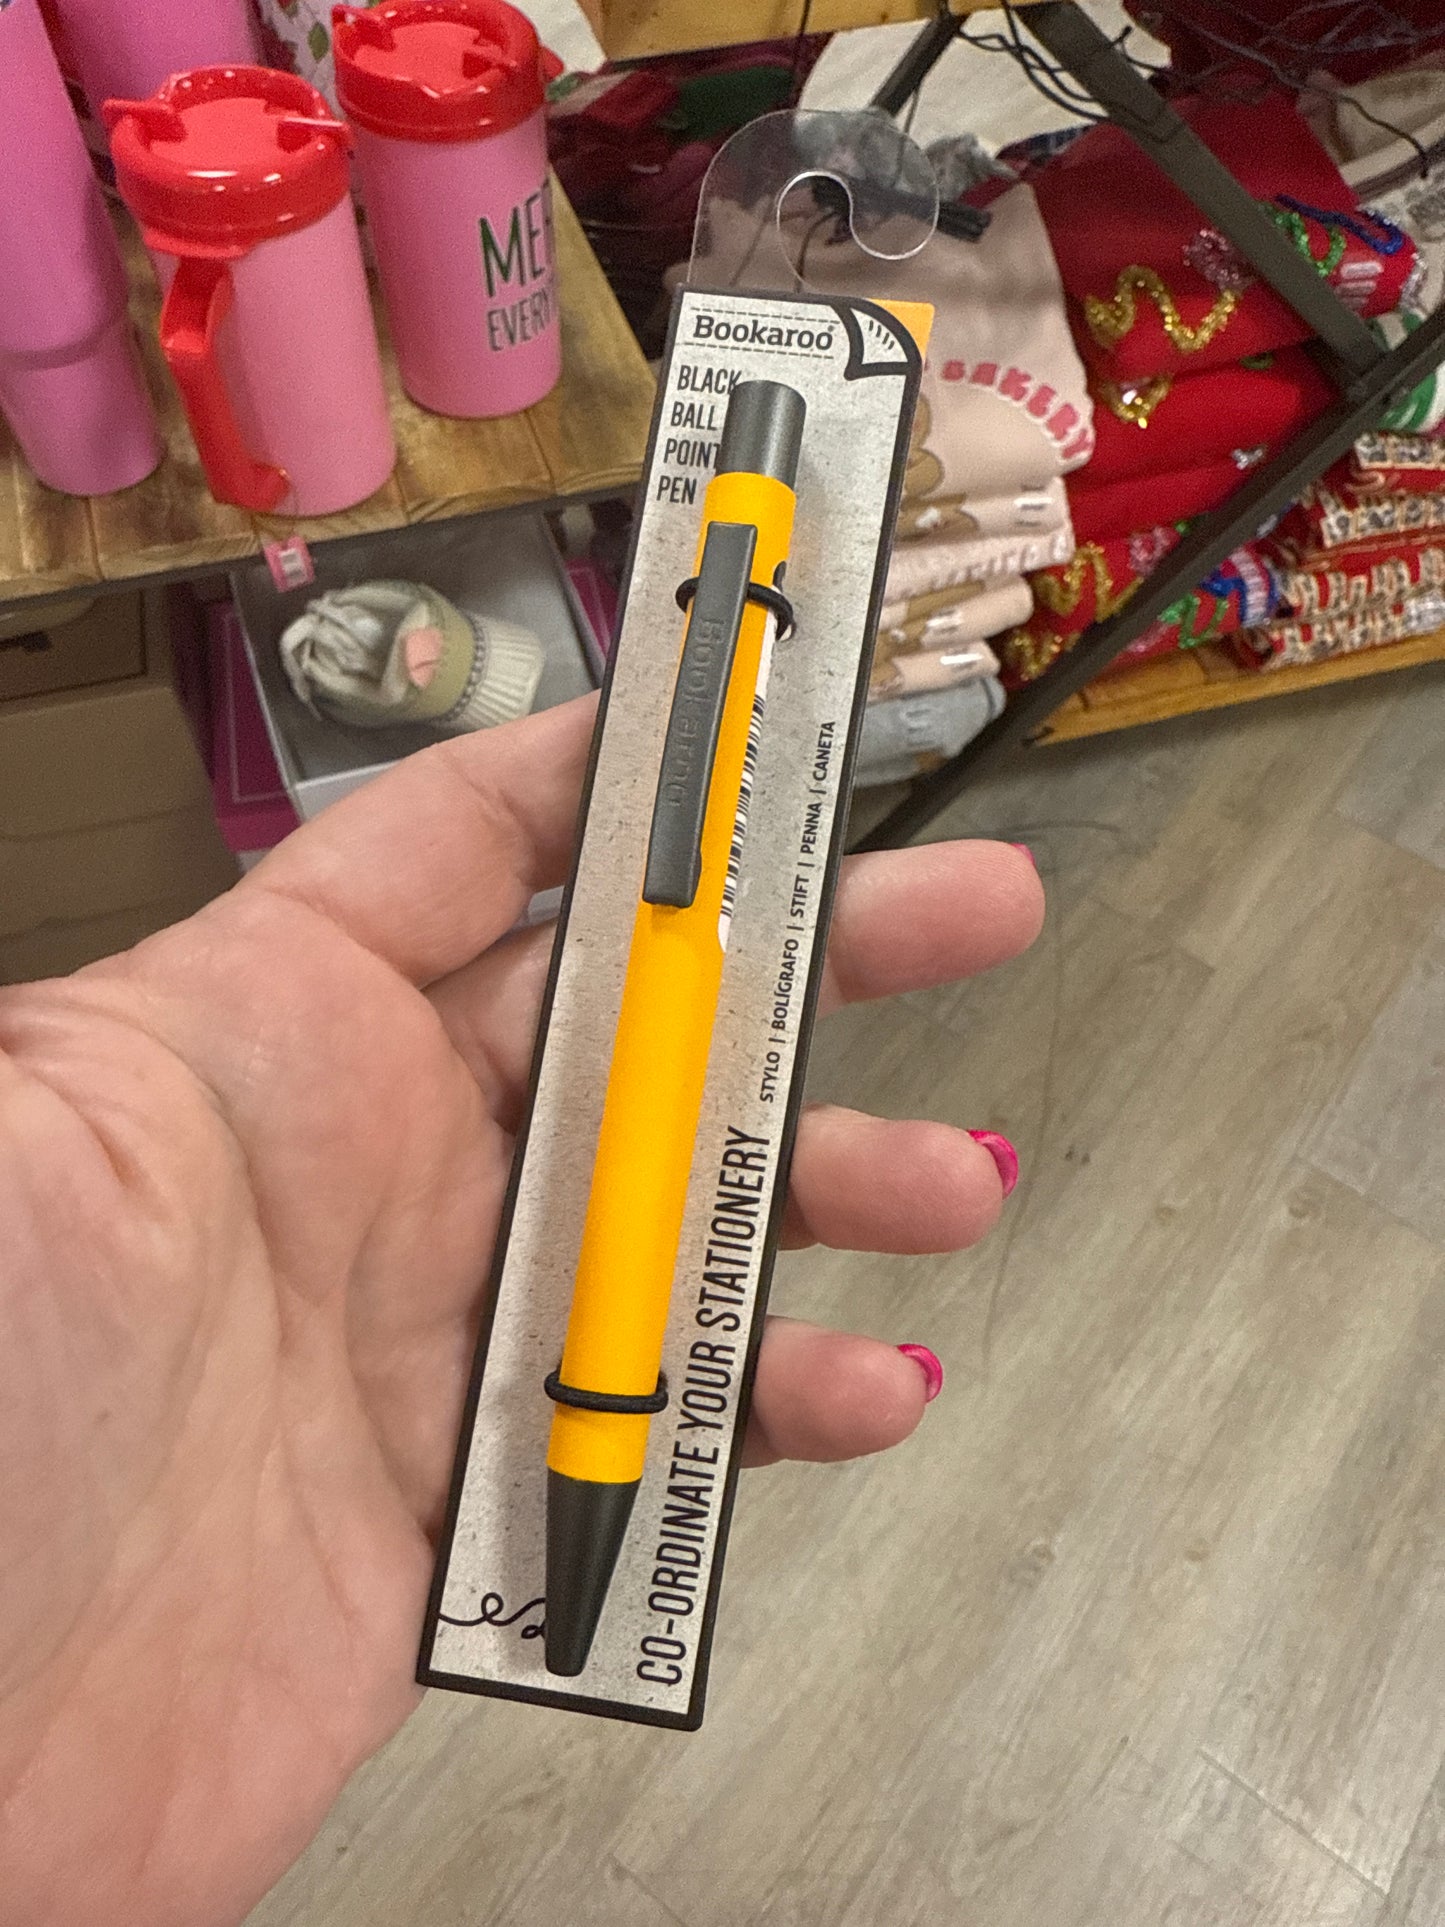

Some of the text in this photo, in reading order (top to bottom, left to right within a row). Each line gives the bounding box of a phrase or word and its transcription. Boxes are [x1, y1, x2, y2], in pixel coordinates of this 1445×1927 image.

[692, 314, 834, 351] Bookaroo
[677, 364, 742, 395] BLACK
[670, 401, 718, 431] BALL
[663, 437, 721, 470] POINT
[656, 475, 698, 505] PEN
[665, 616, 726, 809] Bookaroo
[759, 1050, 781, 1104] STYLO
[771, 938, 800, 1031] BOLÍGRAFO
[790, 873, 810, 919] STIFT
[801, 802, 823, 855] PENNA
[812, 720, 836, 782] CANETA
[636, 1124, 771, 1686] CO-ORDINATE YOUR STATIONERY
